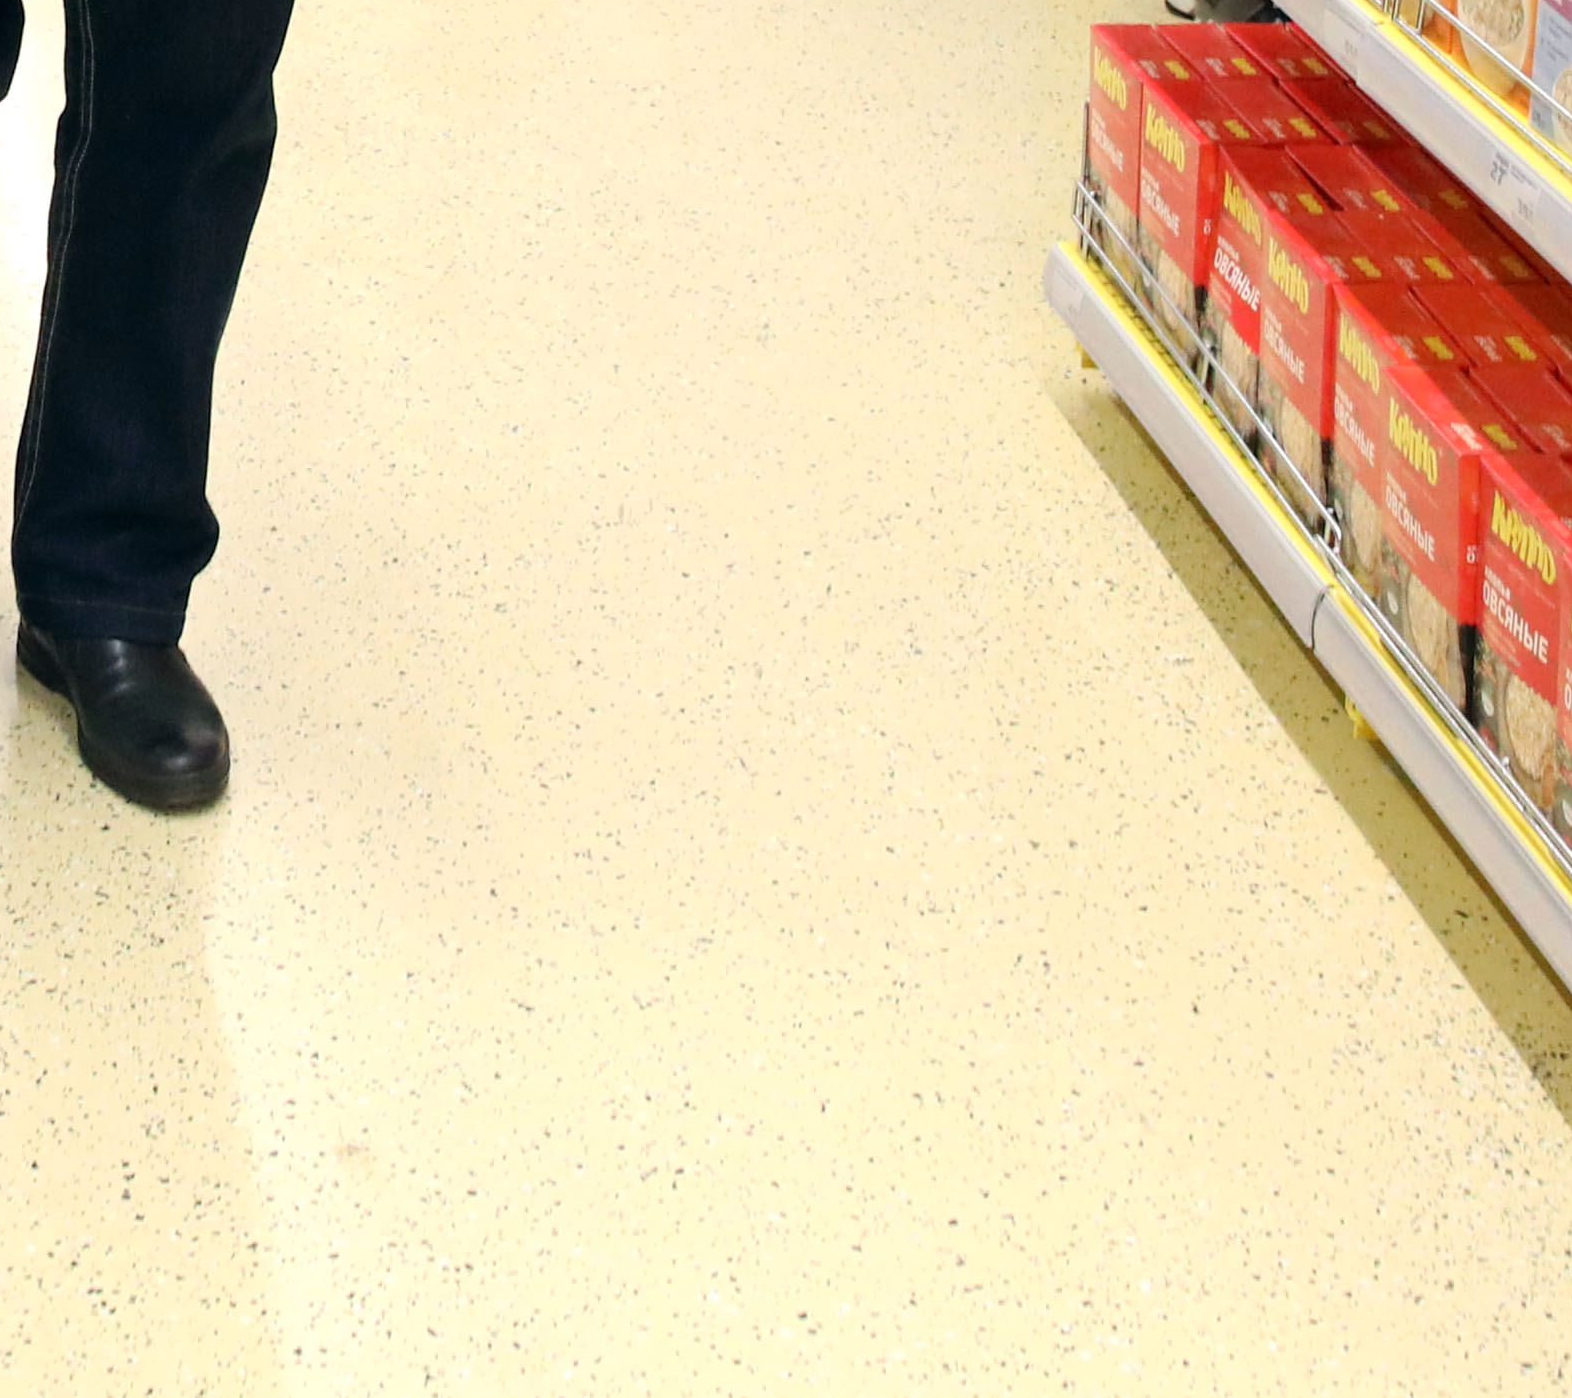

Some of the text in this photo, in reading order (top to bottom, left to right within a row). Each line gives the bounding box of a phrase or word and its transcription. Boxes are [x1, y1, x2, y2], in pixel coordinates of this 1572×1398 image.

[1214, 247, 1260, 312] ОВСЯНЫЕ
[1385, 484, 1435, 562] ОВСЯНЫЕ
[1483, 579, 1548, 666] ОВСЯНЫЕ
